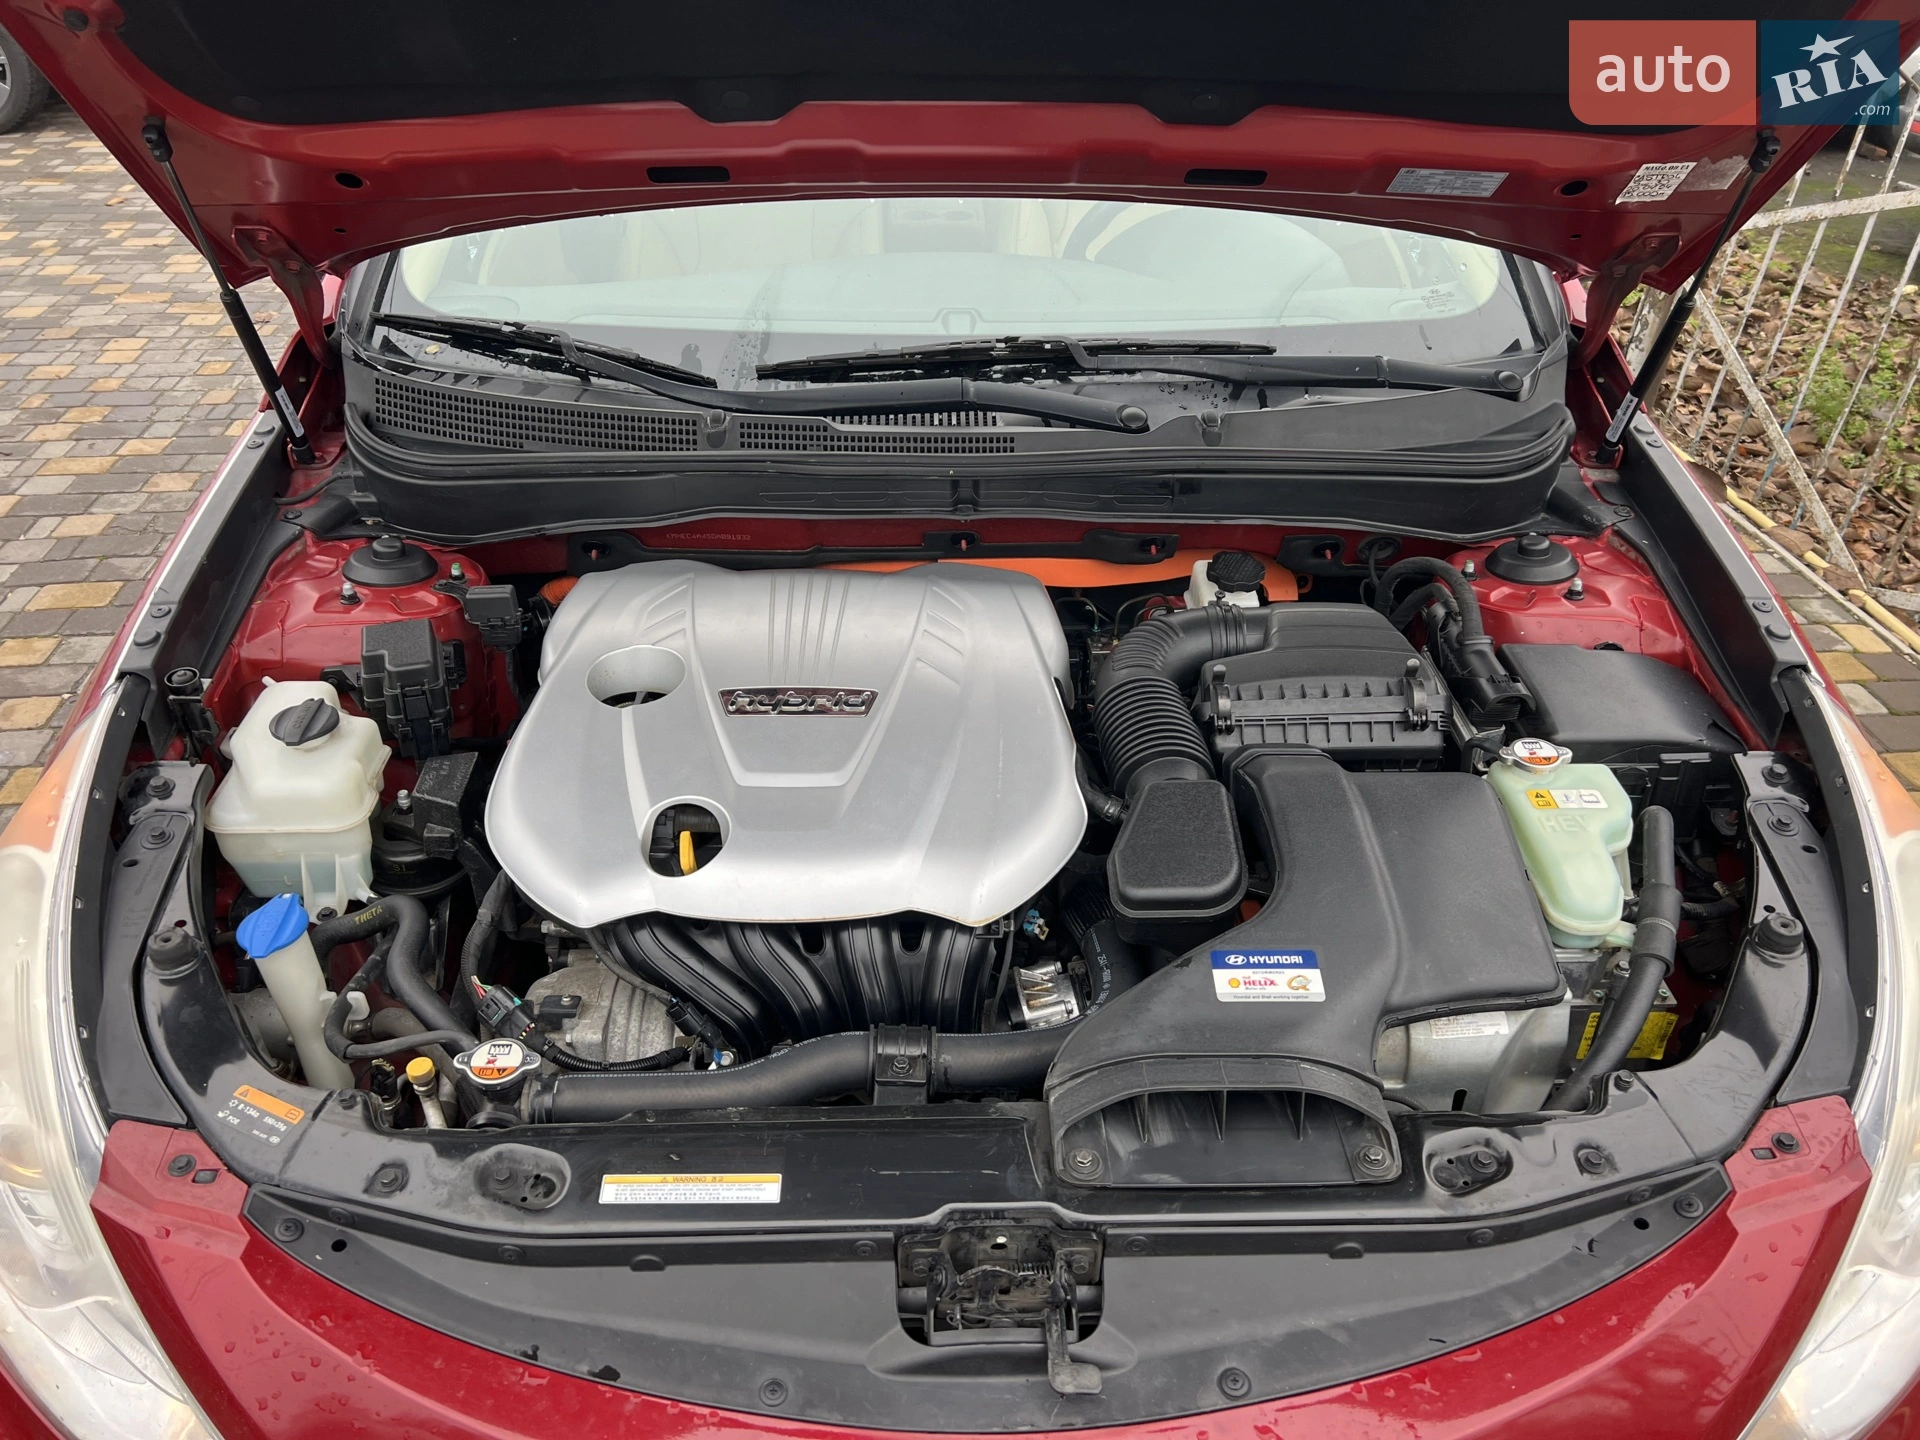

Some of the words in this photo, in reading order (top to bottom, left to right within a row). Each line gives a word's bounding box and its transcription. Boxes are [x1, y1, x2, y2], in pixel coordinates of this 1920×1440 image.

[354, 905, 383, 925] THETA
[1249, 955, 1303, 964] HYUNDAI
[1243, 979, 1277, 987] HELIX
